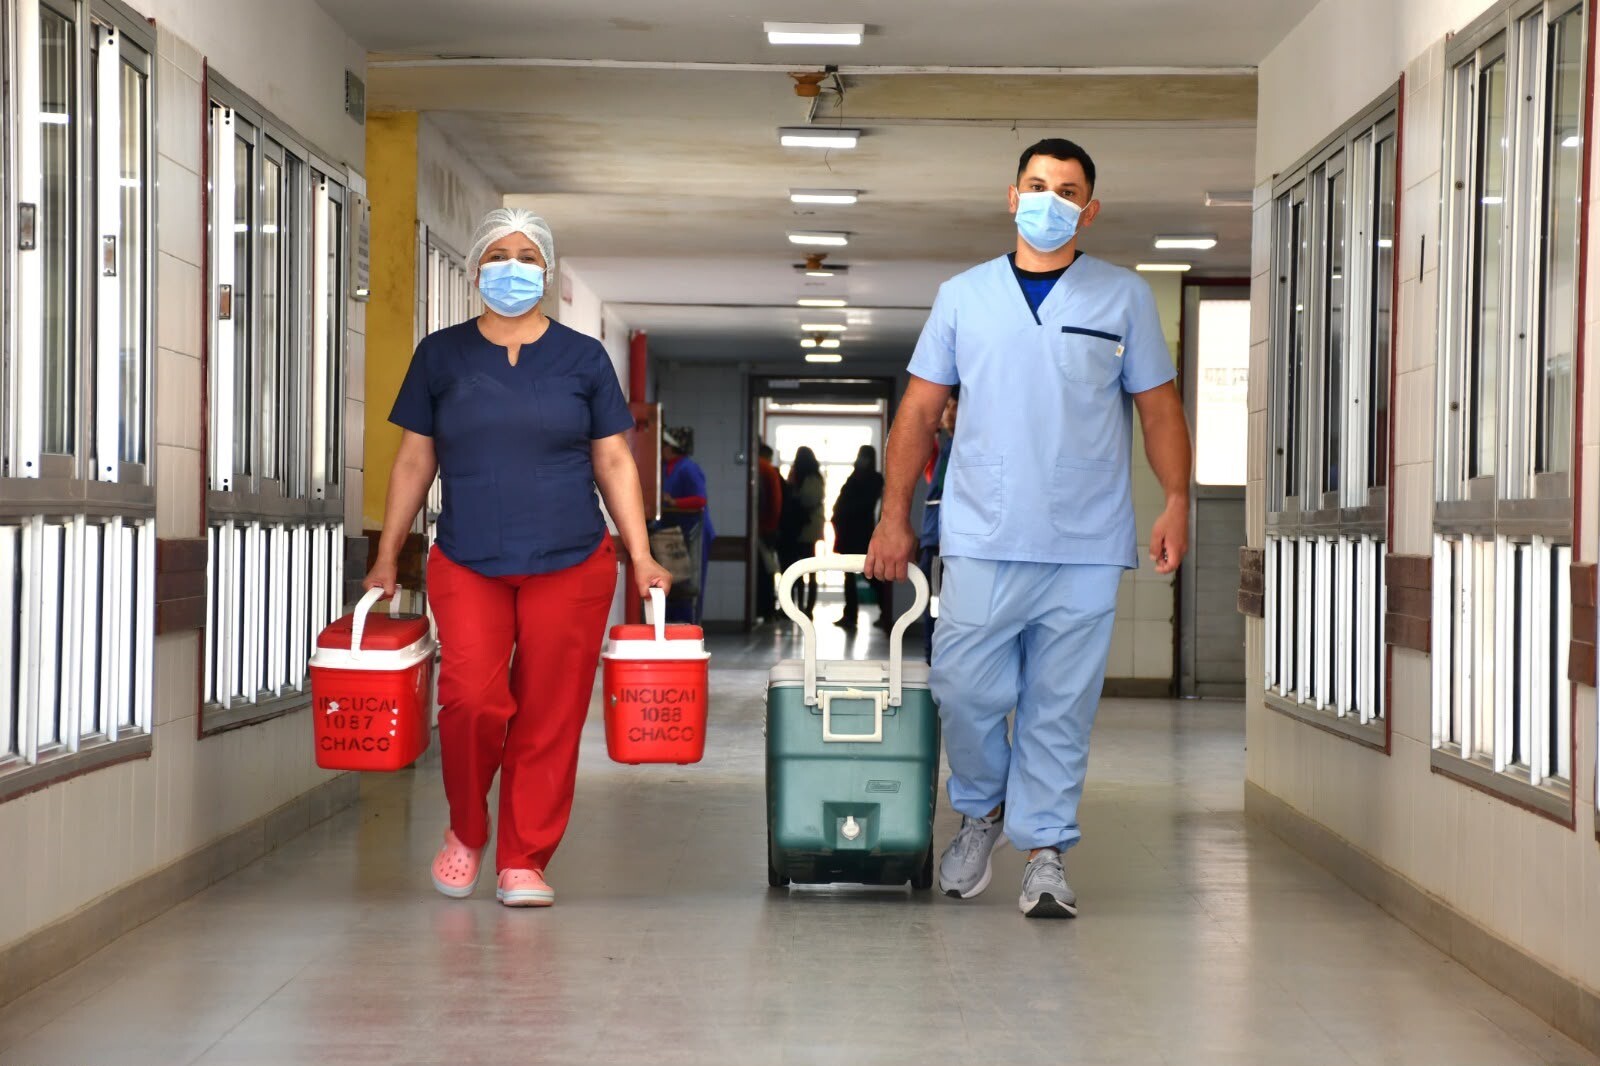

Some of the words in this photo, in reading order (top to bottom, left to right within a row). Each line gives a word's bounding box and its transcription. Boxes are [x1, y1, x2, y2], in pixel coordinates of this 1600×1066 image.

[620, 688, 696, 704] INCUCAI
[324, 714, 374, 730] 1087
[640, 707, 682, 723] 1088
[628, 726, 695, 742] CHACO
[320, 735, 390, 752] CHACO
